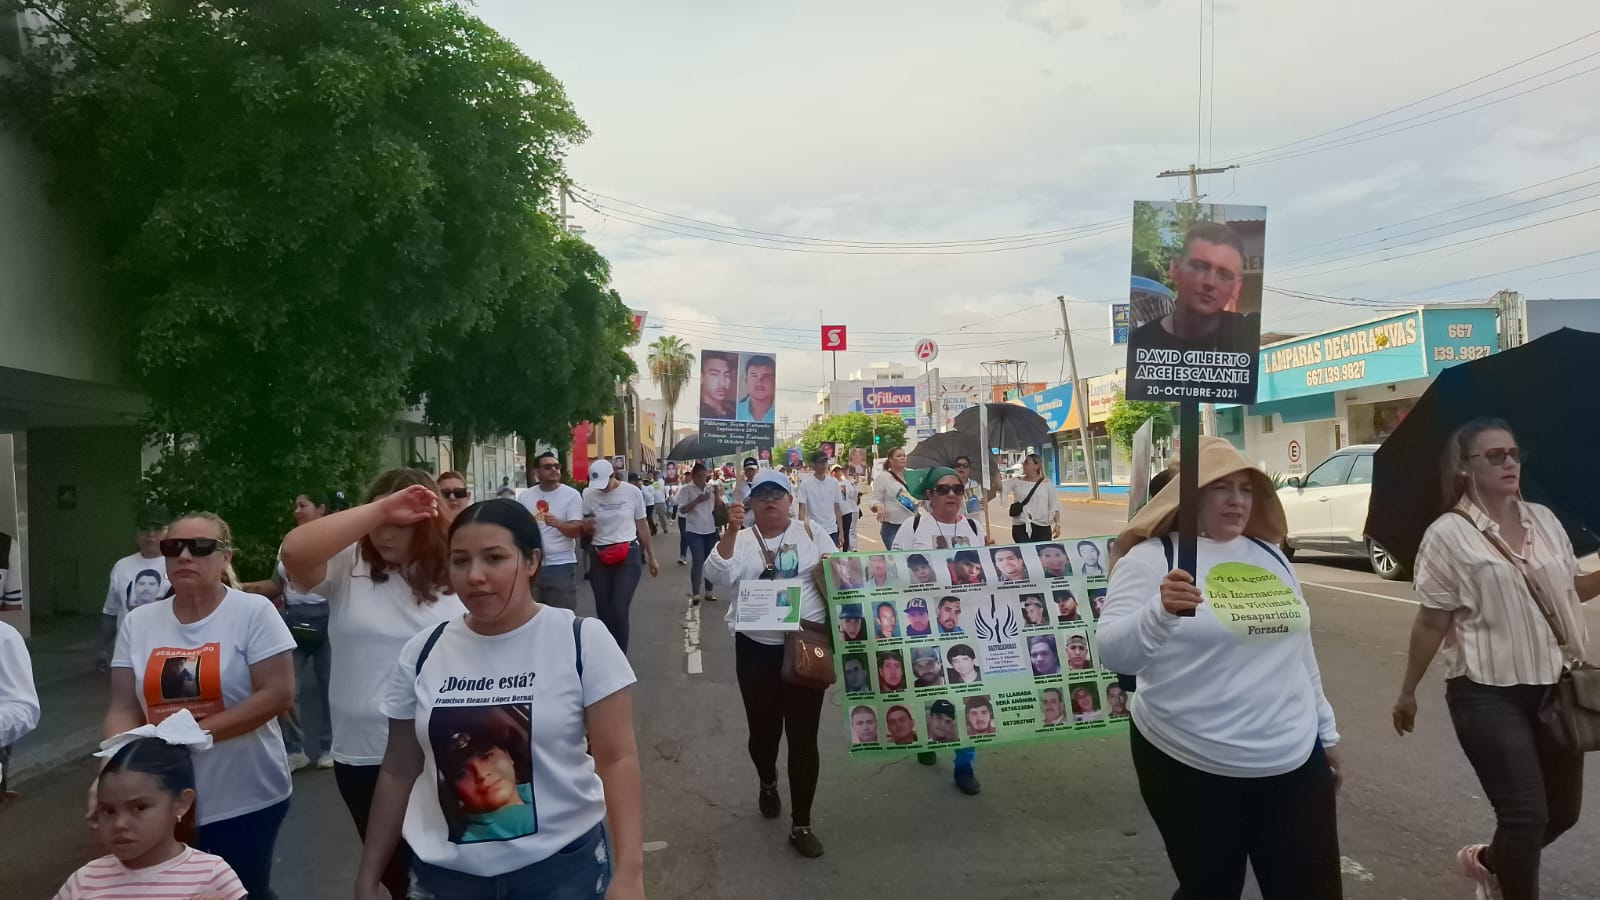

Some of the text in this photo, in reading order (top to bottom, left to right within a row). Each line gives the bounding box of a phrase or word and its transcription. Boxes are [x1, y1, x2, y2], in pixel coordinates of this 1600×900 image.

[1448, 324, 1472, 338] 667
[1264, 318, 1416, 374] LAMPARAS DECORATIVAS
[1434, 346, 1490, 361] 139.9827
[1136, 348, 1250, 368] DAVID GILBERTO
[1135, 365, 1250, 384] ARCE ESCALANTE
[1306, 360, 1366, 386] 667.139.9827
[866, 391, 912, 406] Ofilleva
[1146, 386, 1238, 398] 20-OCTUBRE-2021
[1292, 446, 1296, 457] E
[1231, 610, 1301, 622] Desaparición
[1248, 624, 1288, 634] Forzada
[439, 672, 536, 693] ¿Dónde está?
